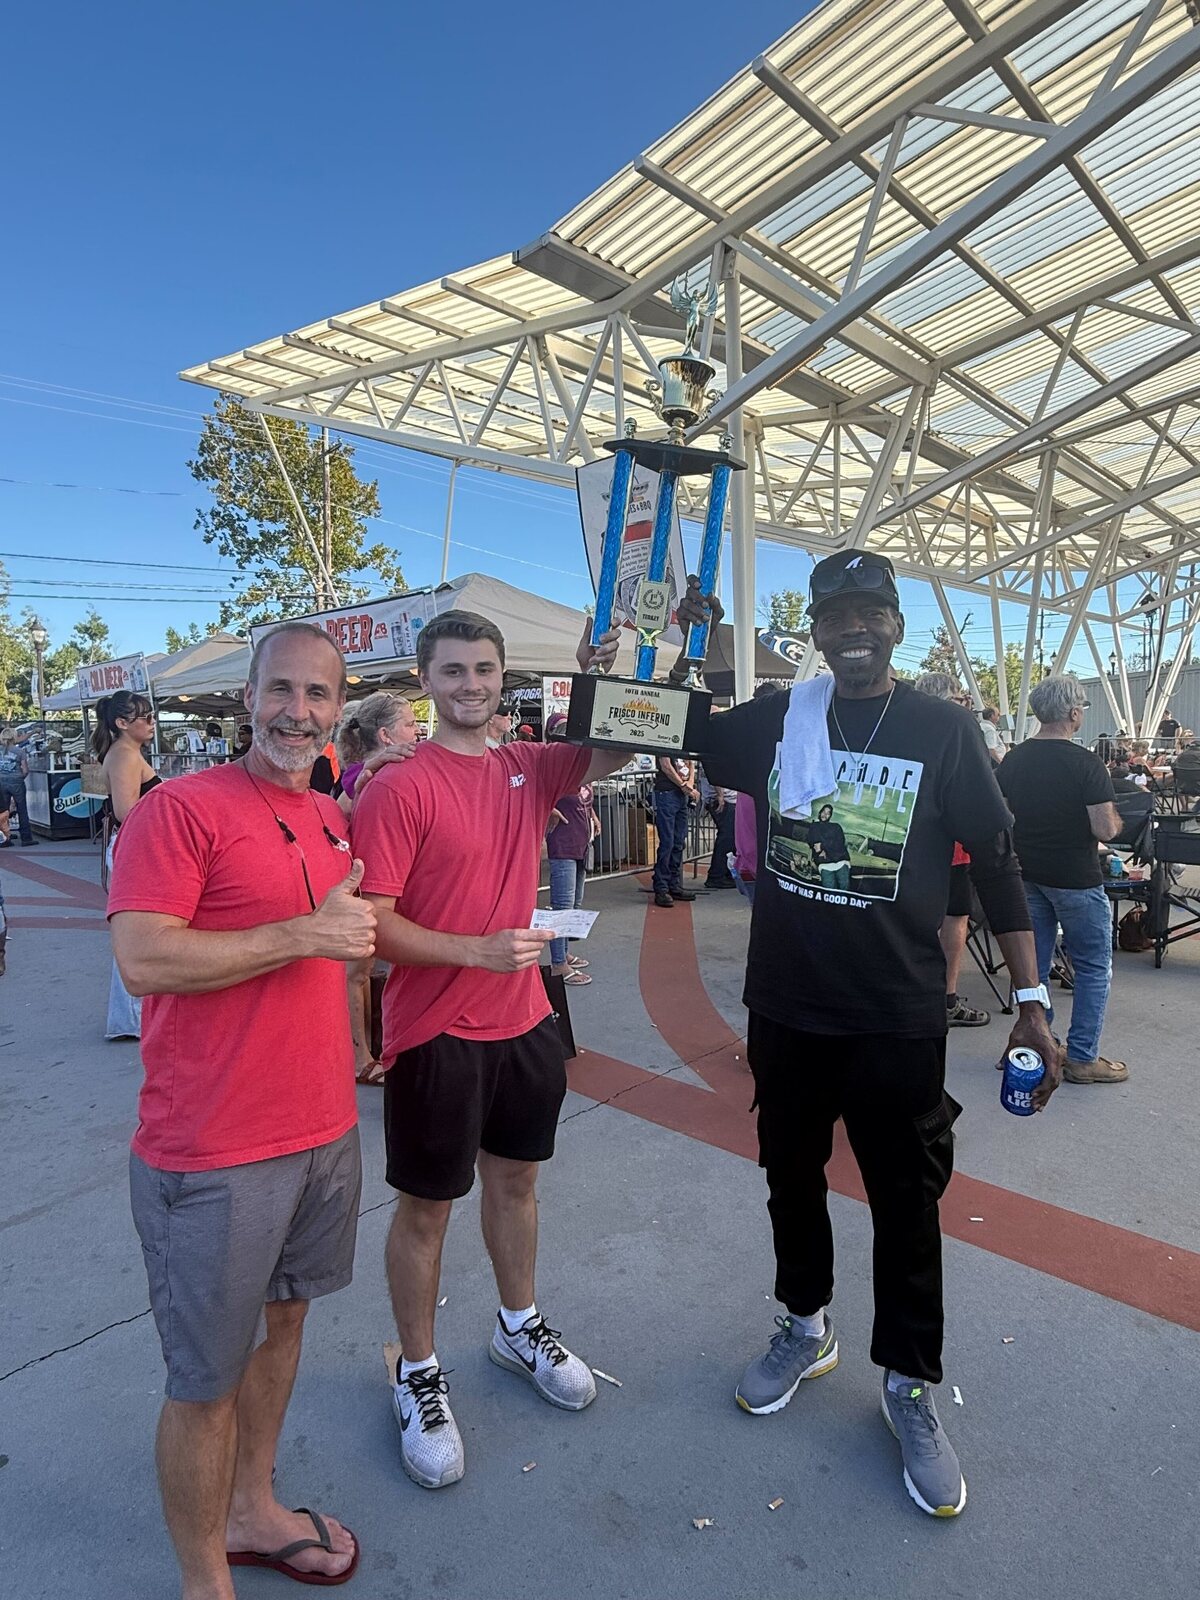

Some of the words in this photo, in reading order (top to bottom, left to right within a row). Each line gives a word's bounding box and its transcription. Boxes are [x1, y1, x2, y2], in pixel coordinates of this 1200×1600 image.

[642, 613, 660, 621] TURKEY
[326, 613, 374, 654] BEER
[552, 680, 572, 697] COL
[625, 688, 639, 696] 10TH
[608, 706, 636, 719] FRISCO
[637, 710, 671, 726] INFERNO
[629, 729, 645, 738] 2025
[54, 793, 81, 811] BLUE
[797, 886, 814, 899] WAS
[815, 892, 822, 901] A
[823, 894, 848, 905] GOOD
[1007, 1094, 1031, 1108] LIG
[1013, 1090, 1033, 1100] BU
